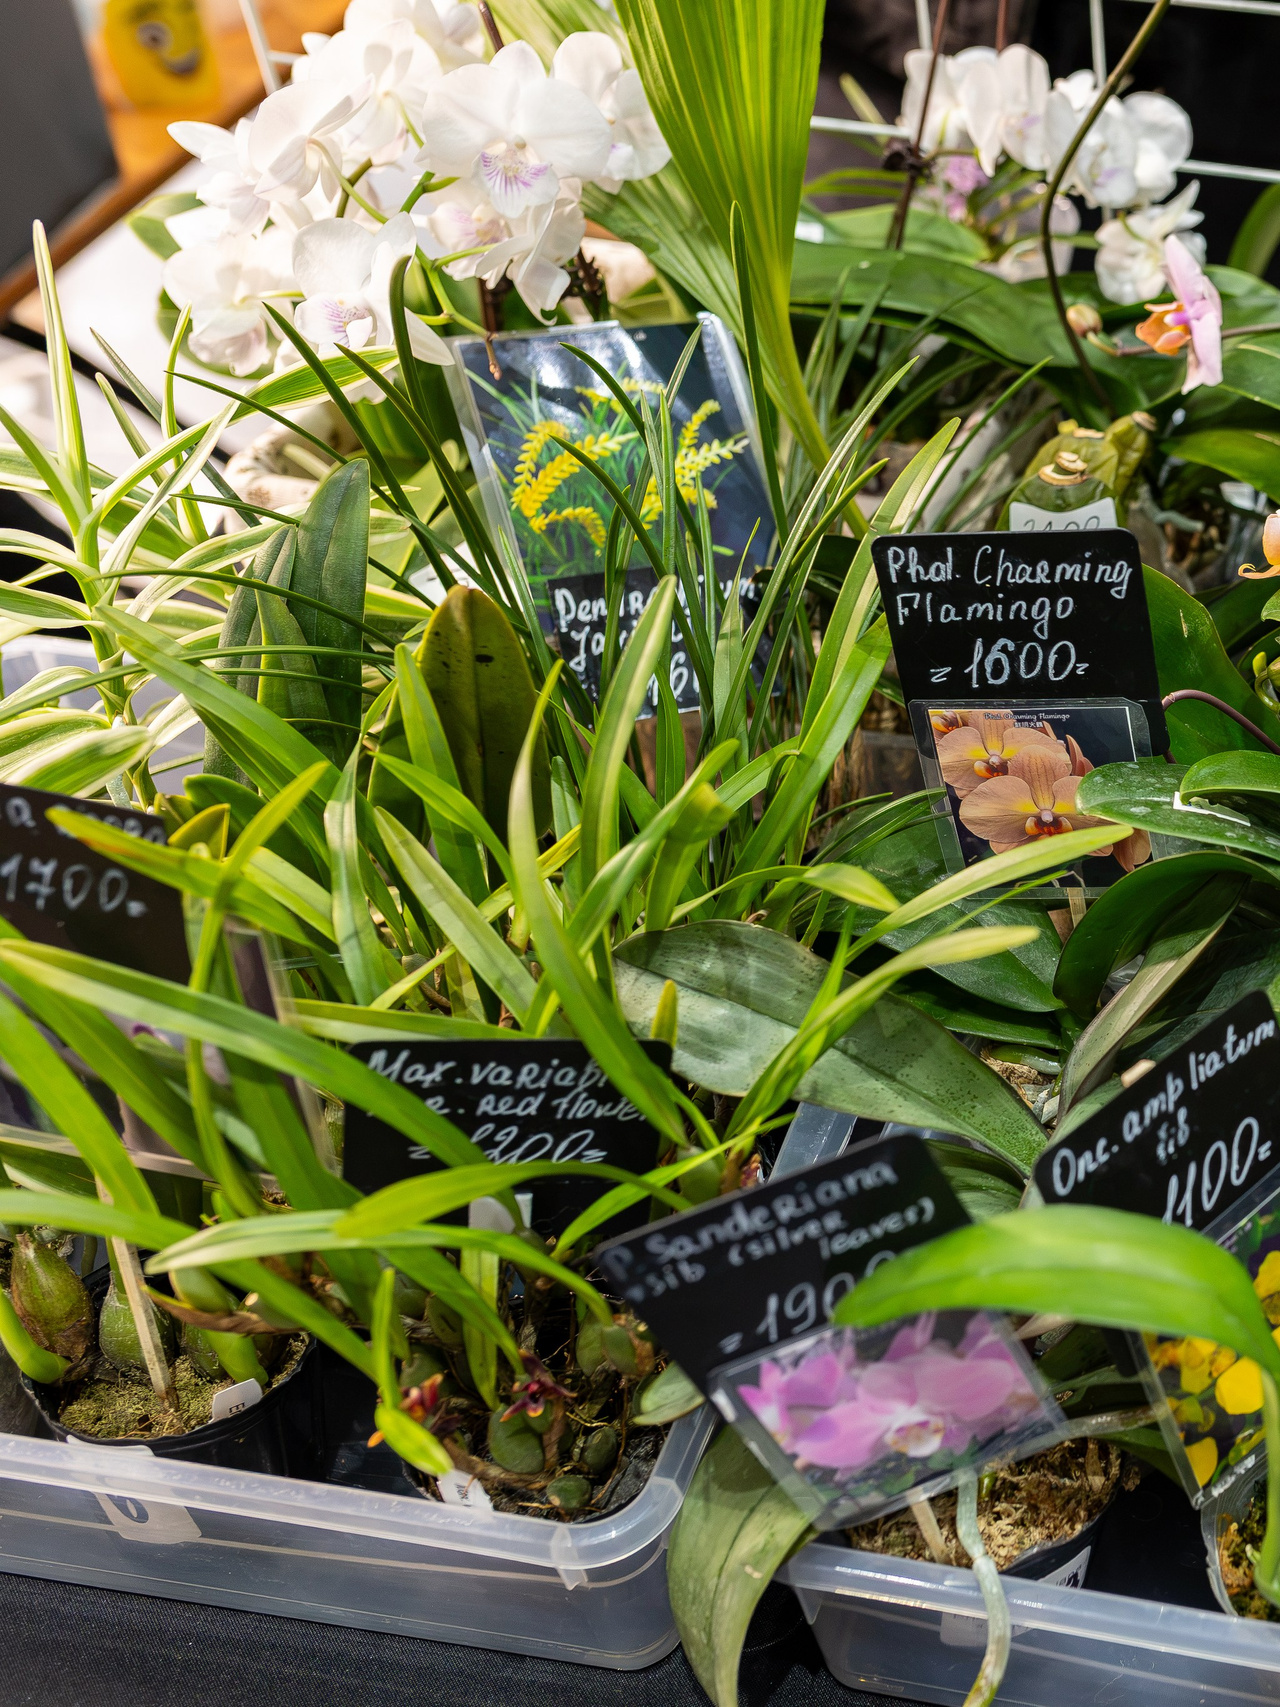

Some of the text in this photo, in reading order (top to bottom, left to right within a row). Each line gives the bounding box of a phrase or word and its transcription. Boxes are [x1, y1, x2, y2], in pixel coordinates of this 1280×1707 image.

[887, 545, 1132, 599] Phal. Charming
[897, 592, 1075, 640] Flamingo
[1052, 1136, 1120, 1197] Onc.
